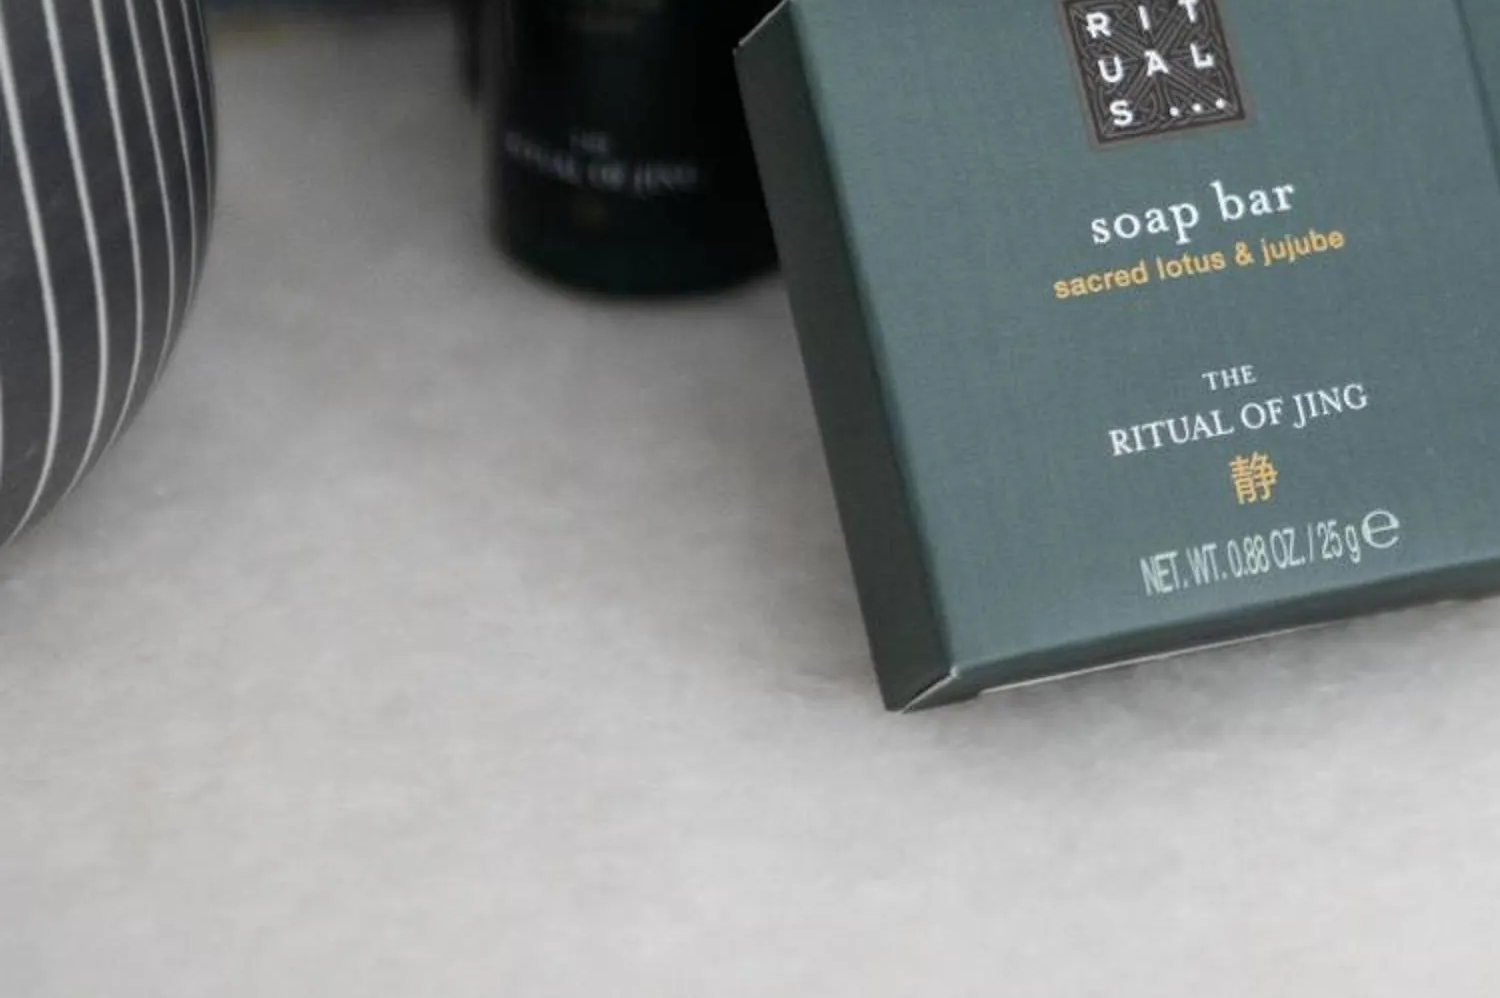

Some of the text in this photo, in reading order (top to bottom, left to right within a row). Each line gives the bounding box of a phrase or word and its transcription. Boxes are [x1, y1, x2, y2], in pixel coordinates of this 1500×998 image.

[1098, 43, 1214, 83] UAL
[1090, 180, 1296, 246] soap bar
[1053, 228, 1345, 300] sacred lotus & jujube
[1201, 365, 1257, 391] THE
[1109, 383, 1369, 456] RITUAL OF JING
[1228, 451, 1279, 505] 静
[1139, 551, 1190, 596] NET.
[1186, 543, 1228, 586] WT.
[1227, 534, 1269, 579] 0.88
[1269, 527, 1306, 569] OZ.
[1316, 519, 1343, 559] 25
